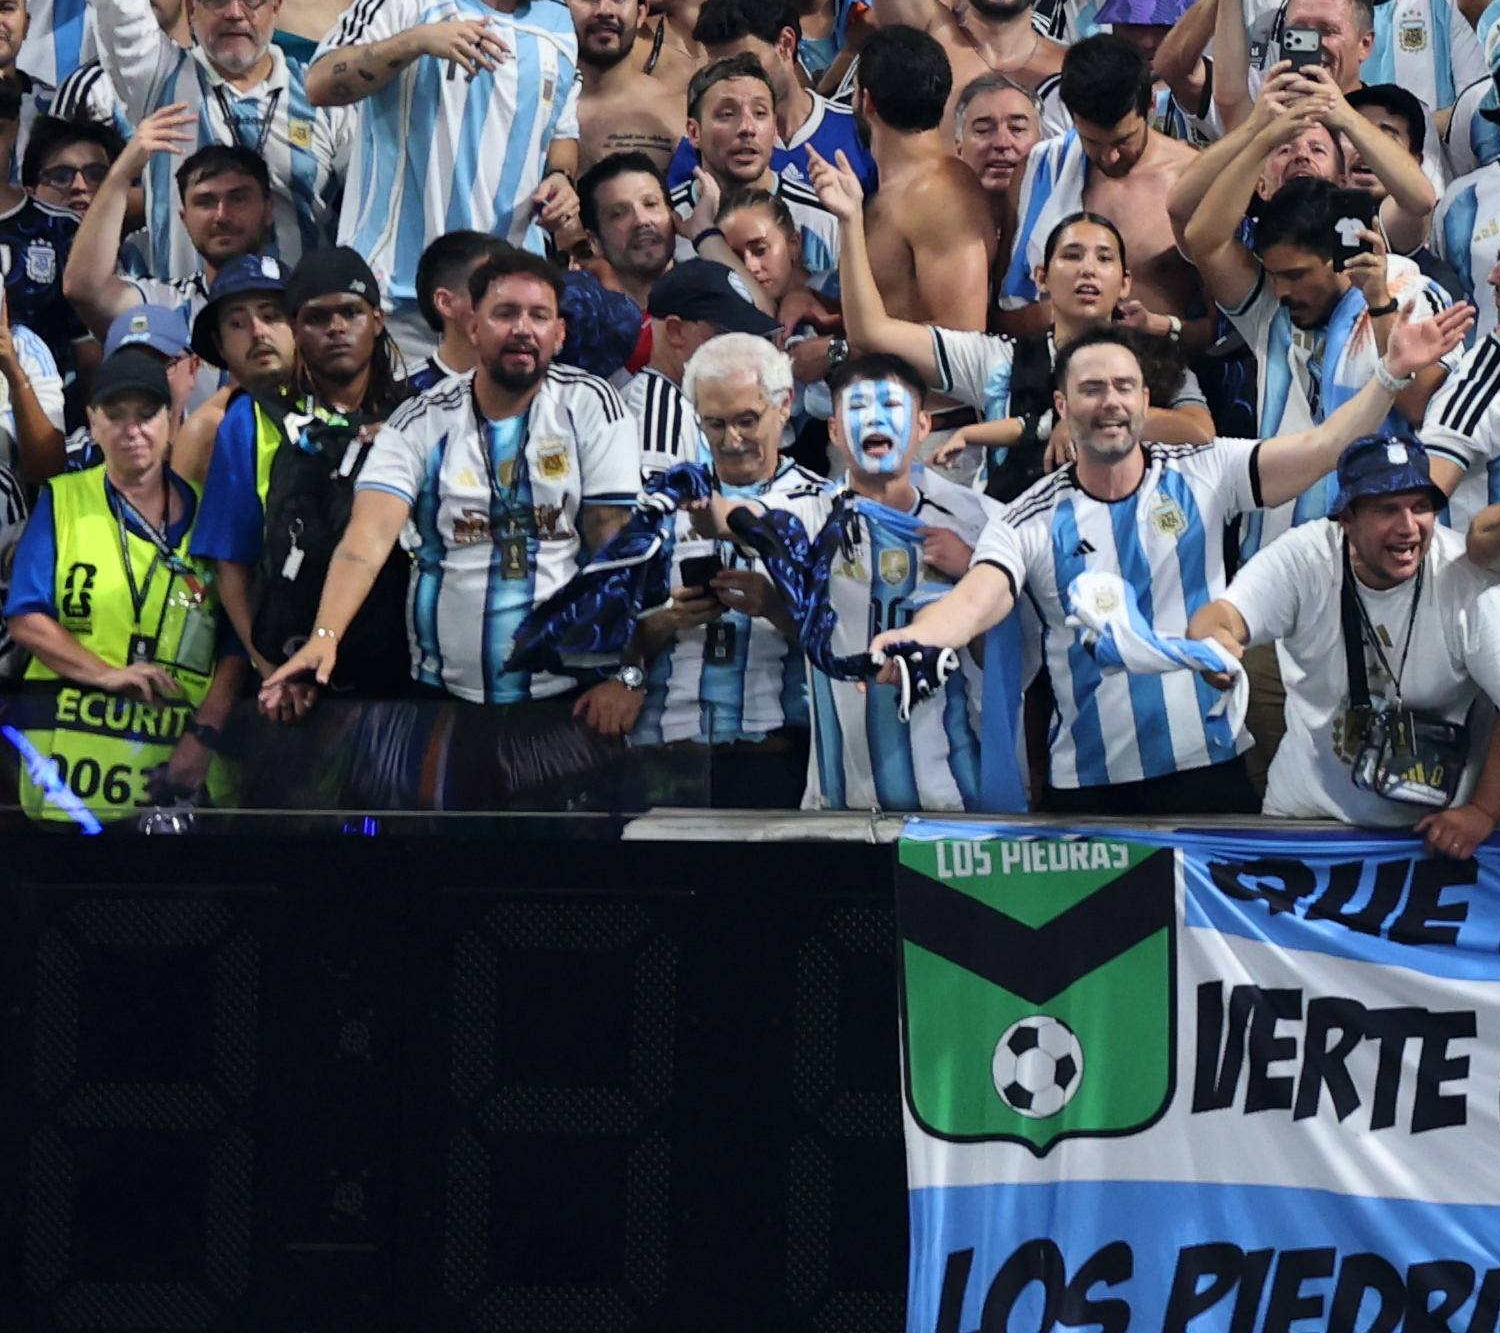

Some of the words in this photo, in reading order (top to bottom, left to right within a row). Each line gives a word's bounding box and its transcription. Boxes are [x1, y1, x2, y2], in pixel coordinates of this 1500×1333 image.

[57, 688, 192, 737] ECURIT
[935, 839, 992, 880] LOS
[1190, 980, 1478, 1135] VERTE
